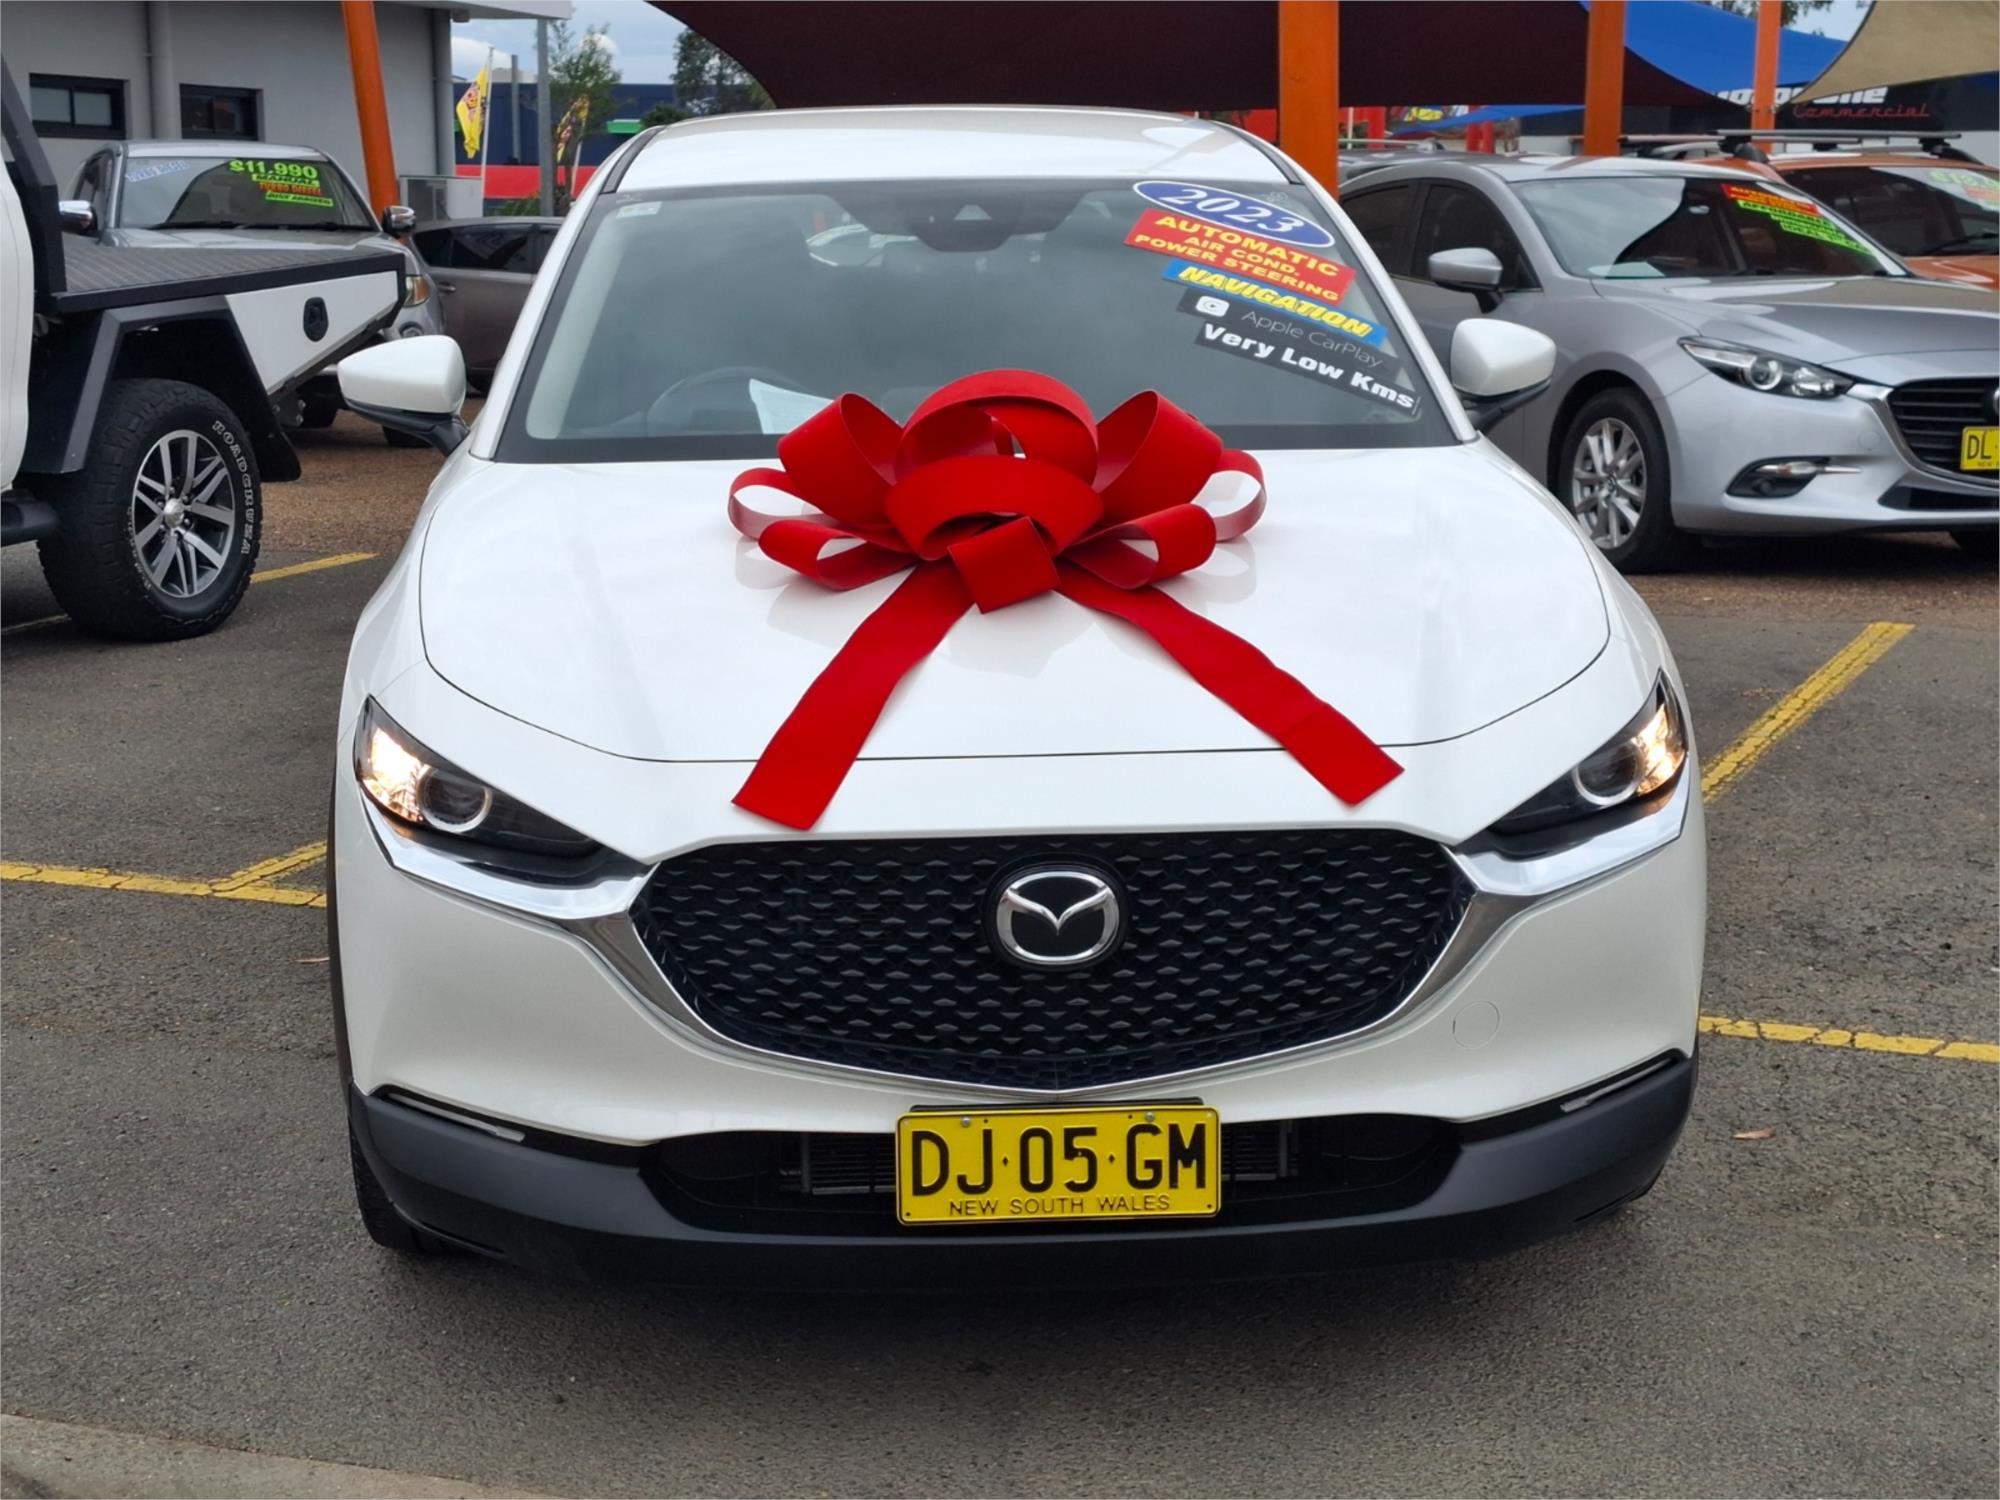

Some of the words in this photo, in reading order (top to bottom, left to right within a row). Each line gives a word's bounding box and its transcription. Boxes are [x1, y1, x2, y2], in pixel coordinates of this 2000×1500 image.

[1792, 102, 1931, 119] Commercial
[1158, 188, 1305, 233] 2023
[1134, 234, 1218, 262] POWER
[1223, 257, 1339, 301] STEERING
[1154, 216, 1340, 276] AUTOMATIC
[1183, 236, 1226, 253] AIR
[1230, 249, 1300, 277] COND.
[1178, 266, 1373, 338] NAVIGATION
[1204, 322, 1276, 358] Very
[1281, 346, 1344, 380] Low
[1350, 371, 1415, 408] Kms
[1241, 310, 1304, 338] Apple
[1308, 331, 1384, 368] CarPlay
[949, 1199, 999, 1217] NEW
[1009, 1196, 1085, 1215] SOUTH
[1098, 1194, 1171, 1212] WALES
